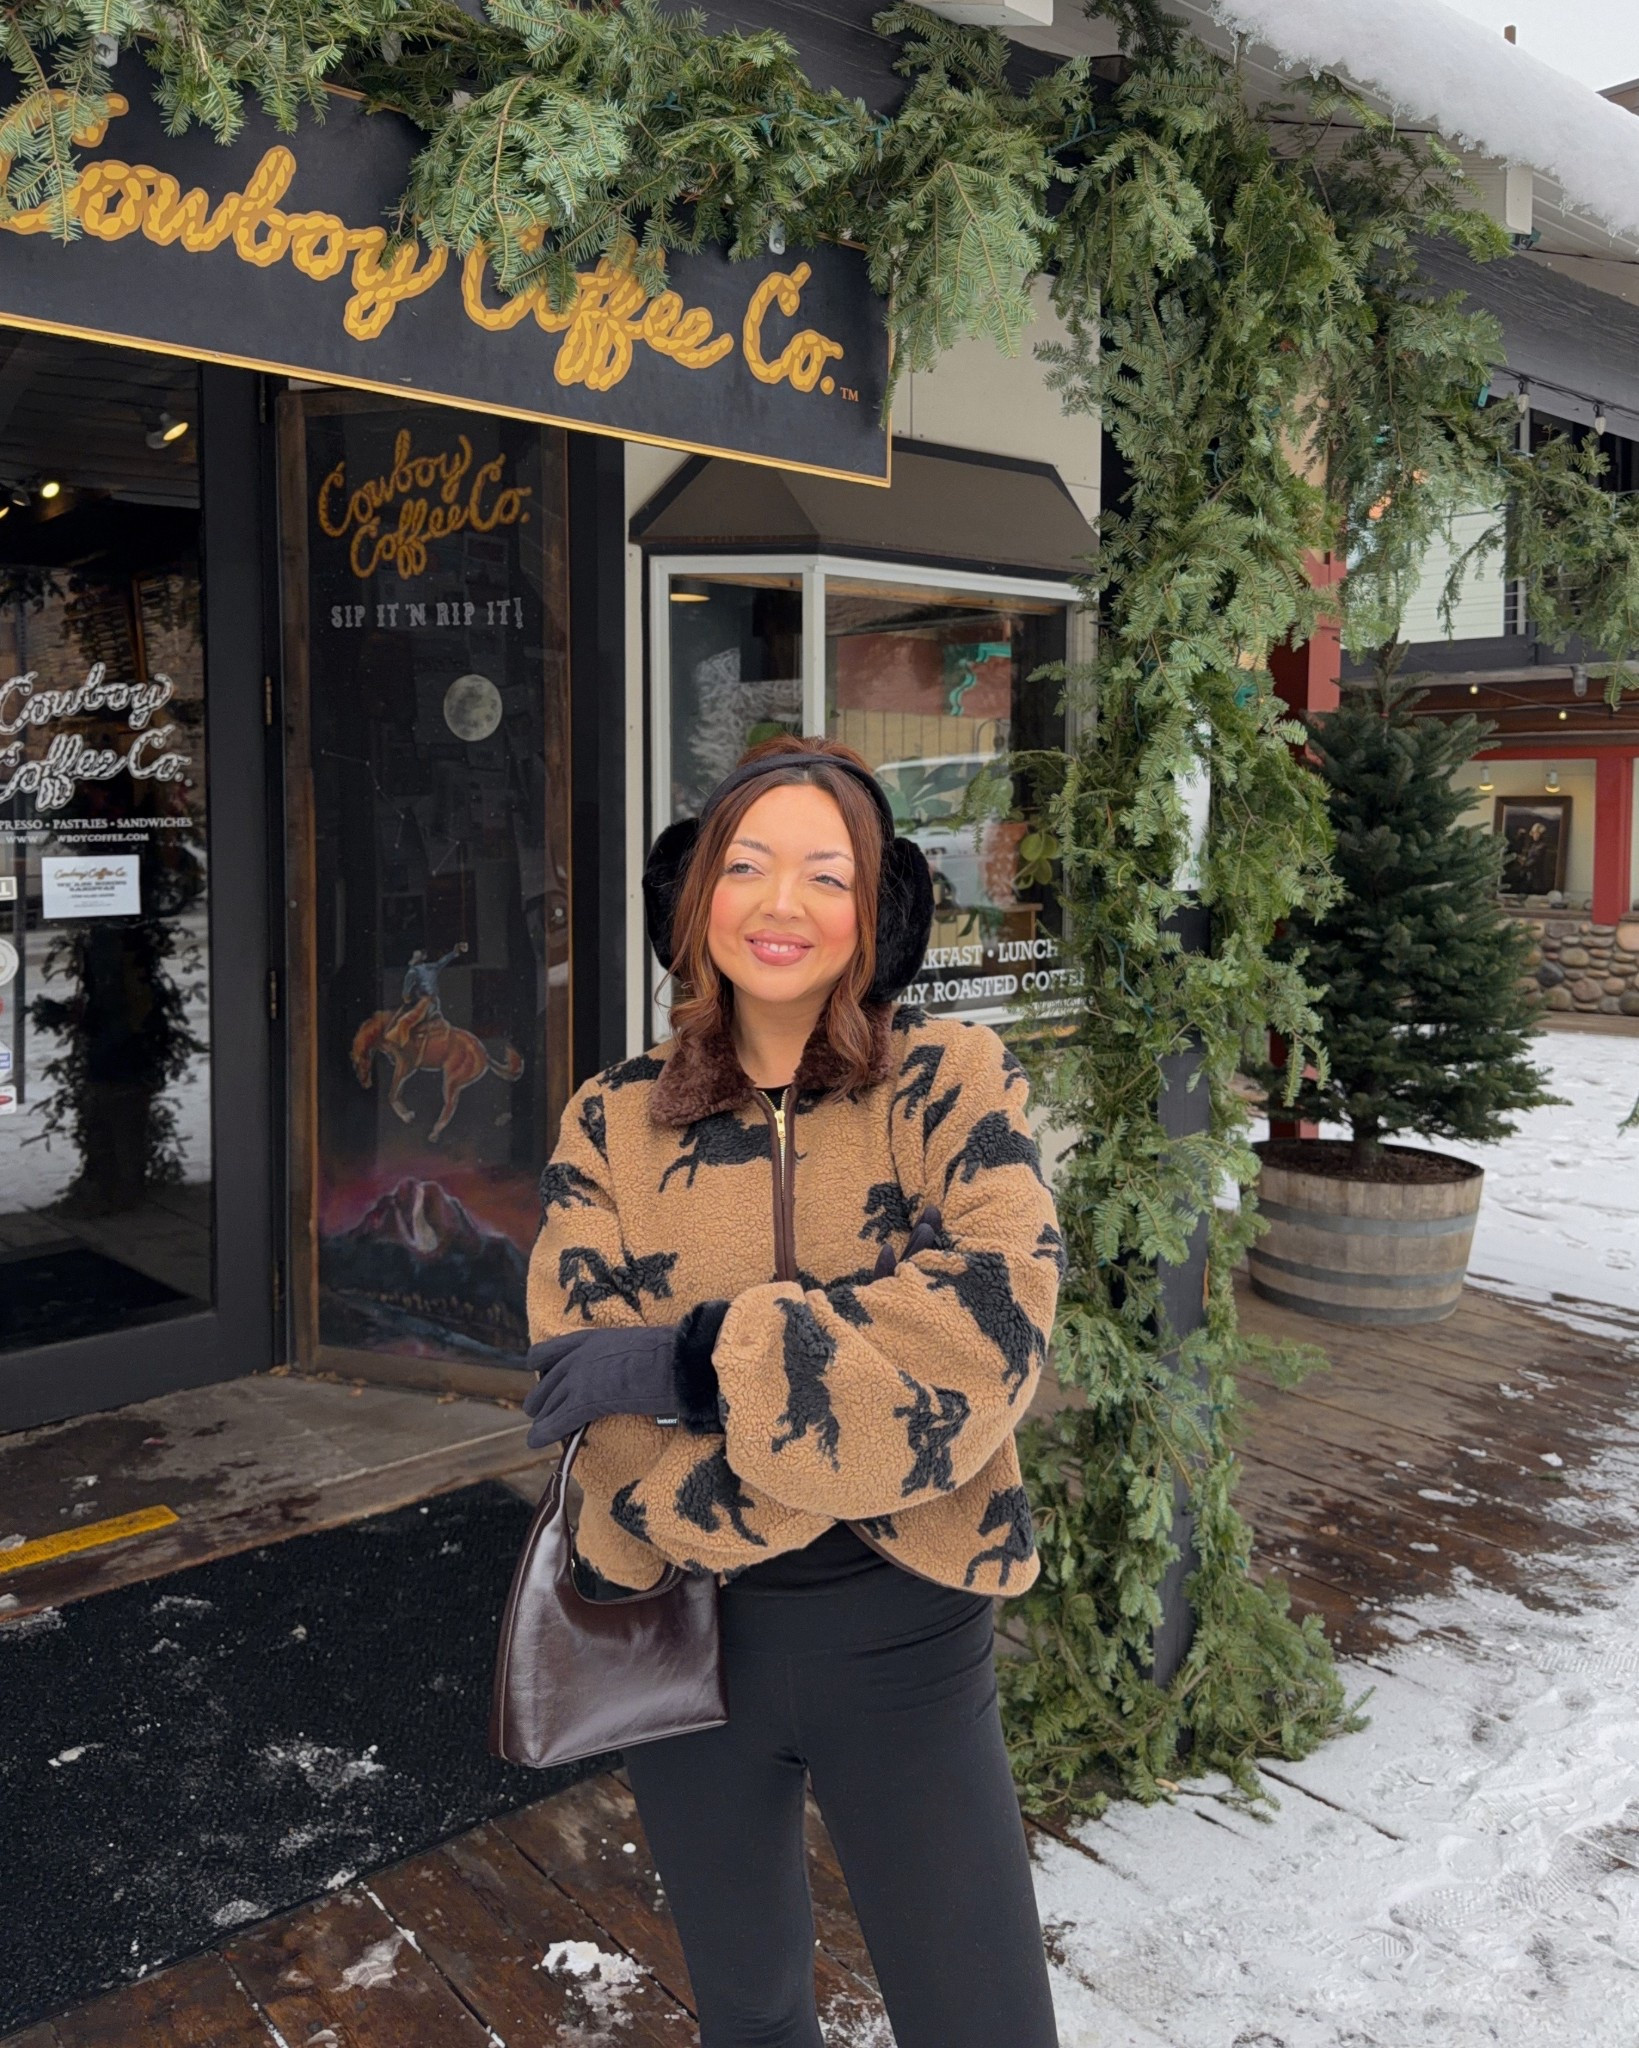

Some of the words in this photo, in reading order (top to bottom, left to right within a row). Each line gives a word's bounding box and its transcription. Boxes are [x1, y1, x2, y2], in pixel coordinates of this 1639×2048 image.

[743, 262, 844, 395] Co.
[319, 428, 473, 537] Cowboy
[351, 498, 469, 580] Coffee
[469, 453, 533, 532] Co.
[331, 605, 366, 628] SIP
[376, 602, 400, 627] IT
[436, 602, 475, 626] RIP
[487, 597, 523, 629] IT!
[0, 662, 173, 735] Cowboy
[128, 724, 192, 783] Co.
[53, 818, 108, 829] PASTRIES
[117, 817, 192, 828] SANDWICHES
[932, 974, 1018, 1003] ROASTED
